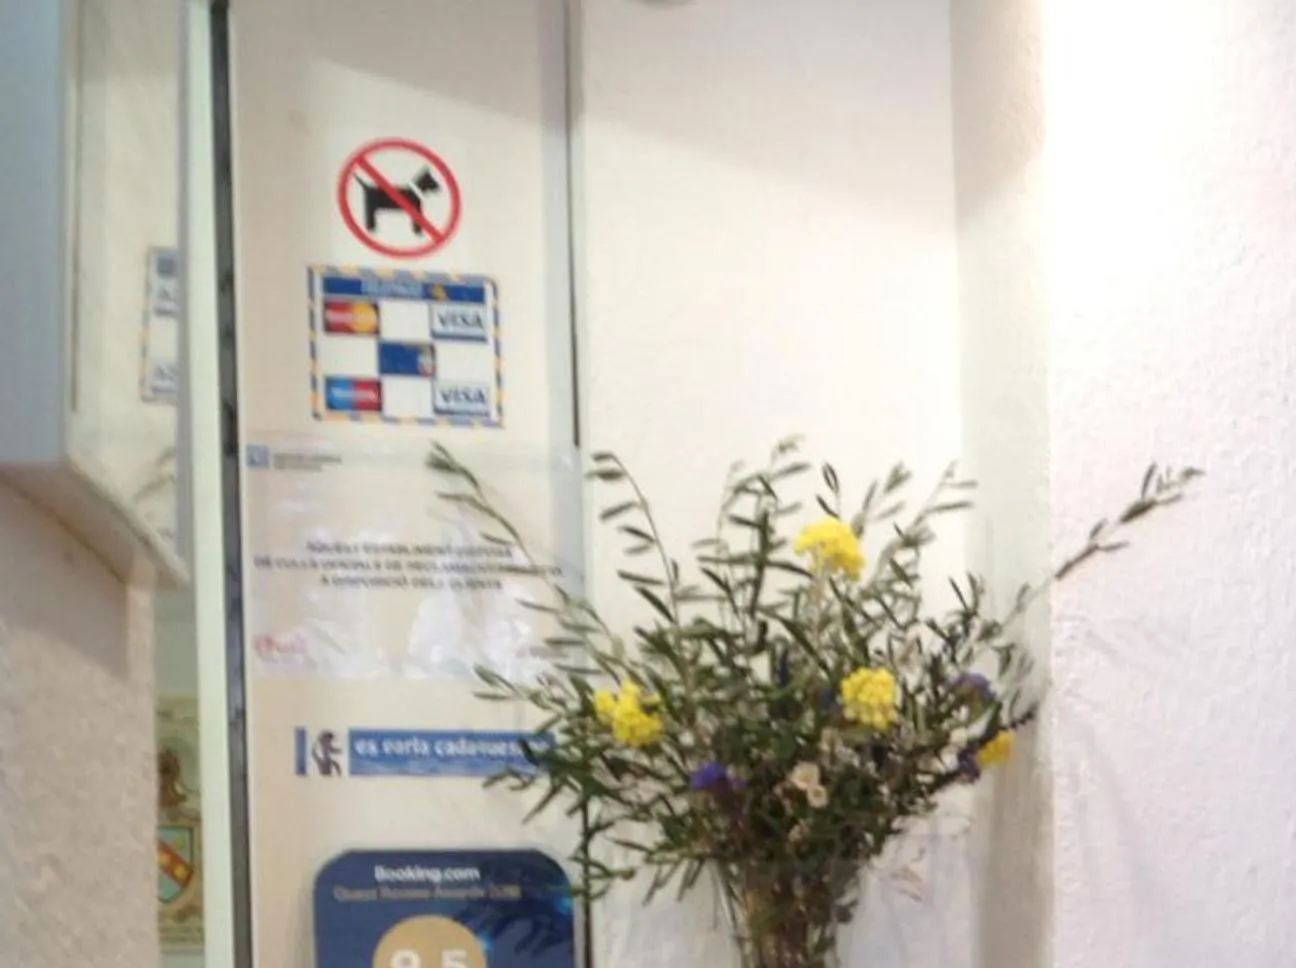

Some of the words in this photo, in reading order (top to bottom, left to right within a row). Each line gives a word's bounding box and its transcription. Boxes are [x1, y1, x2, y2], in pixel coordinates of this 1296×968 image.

[437, 313, 484, 330] VISA
[440, 385, 487, 404] VISA
[373, 864, 482, 883] Booking.com
